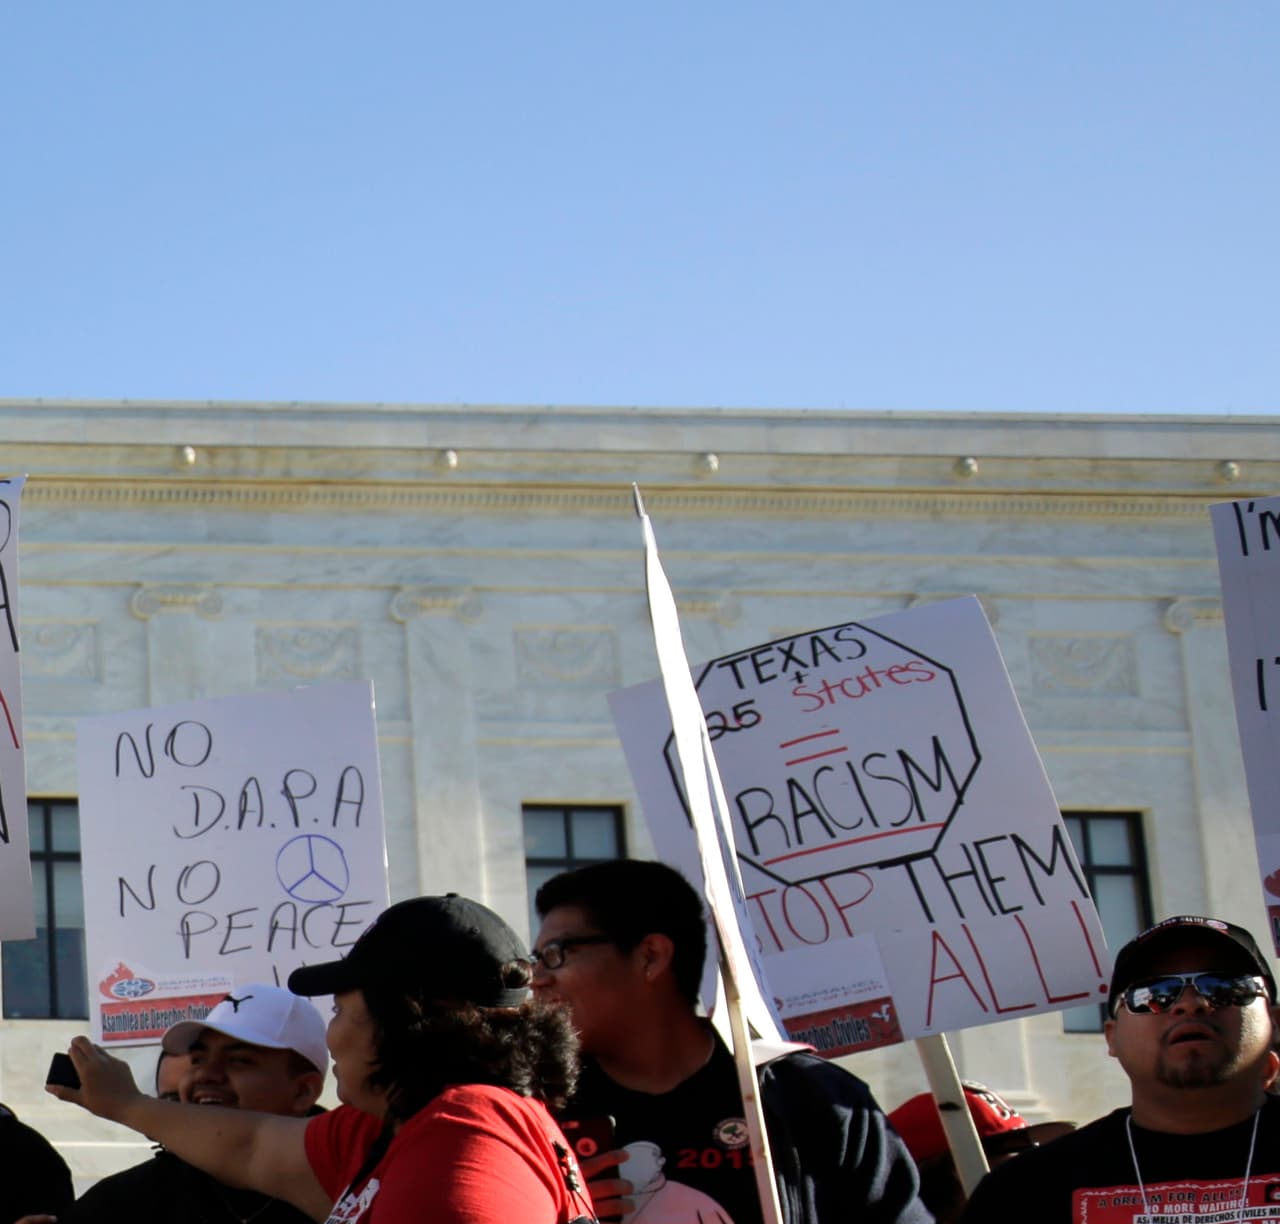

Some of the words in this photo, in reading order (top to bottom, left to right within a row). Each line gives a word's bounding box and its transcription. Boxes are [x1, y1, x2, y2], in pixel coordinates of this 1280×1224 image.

[718, 626, 868, 691] TEXAS
[704, 700, 762, 742] 25
[792, 660, 937, 713] States
[115, 720, 213, 779] NO
[173, 765, 365, 840] D.A.P.A
[735, 735, 964, 857] RACISM
[118, 860, 221, 917] NO
[745, 871, 875, 953] TOP
[878, 824, 1091, 923] THEM
[175, 900, 372, 959] PEACE
[925, 900, 1109, 1027] ALL!
[102, 1010, 139, 1033] Asamblea
[676, 1147, 753, 1169] 201
[1112, 1193, 1162, 1206] DREM
[1168, 1192, 1196, 1203] FOR
[1164, 1203, 1195, 1214] MORE
[1182, 1214, 1193, 1224] DE
[1195, 1211, 1235, 1224] DERECHOS
